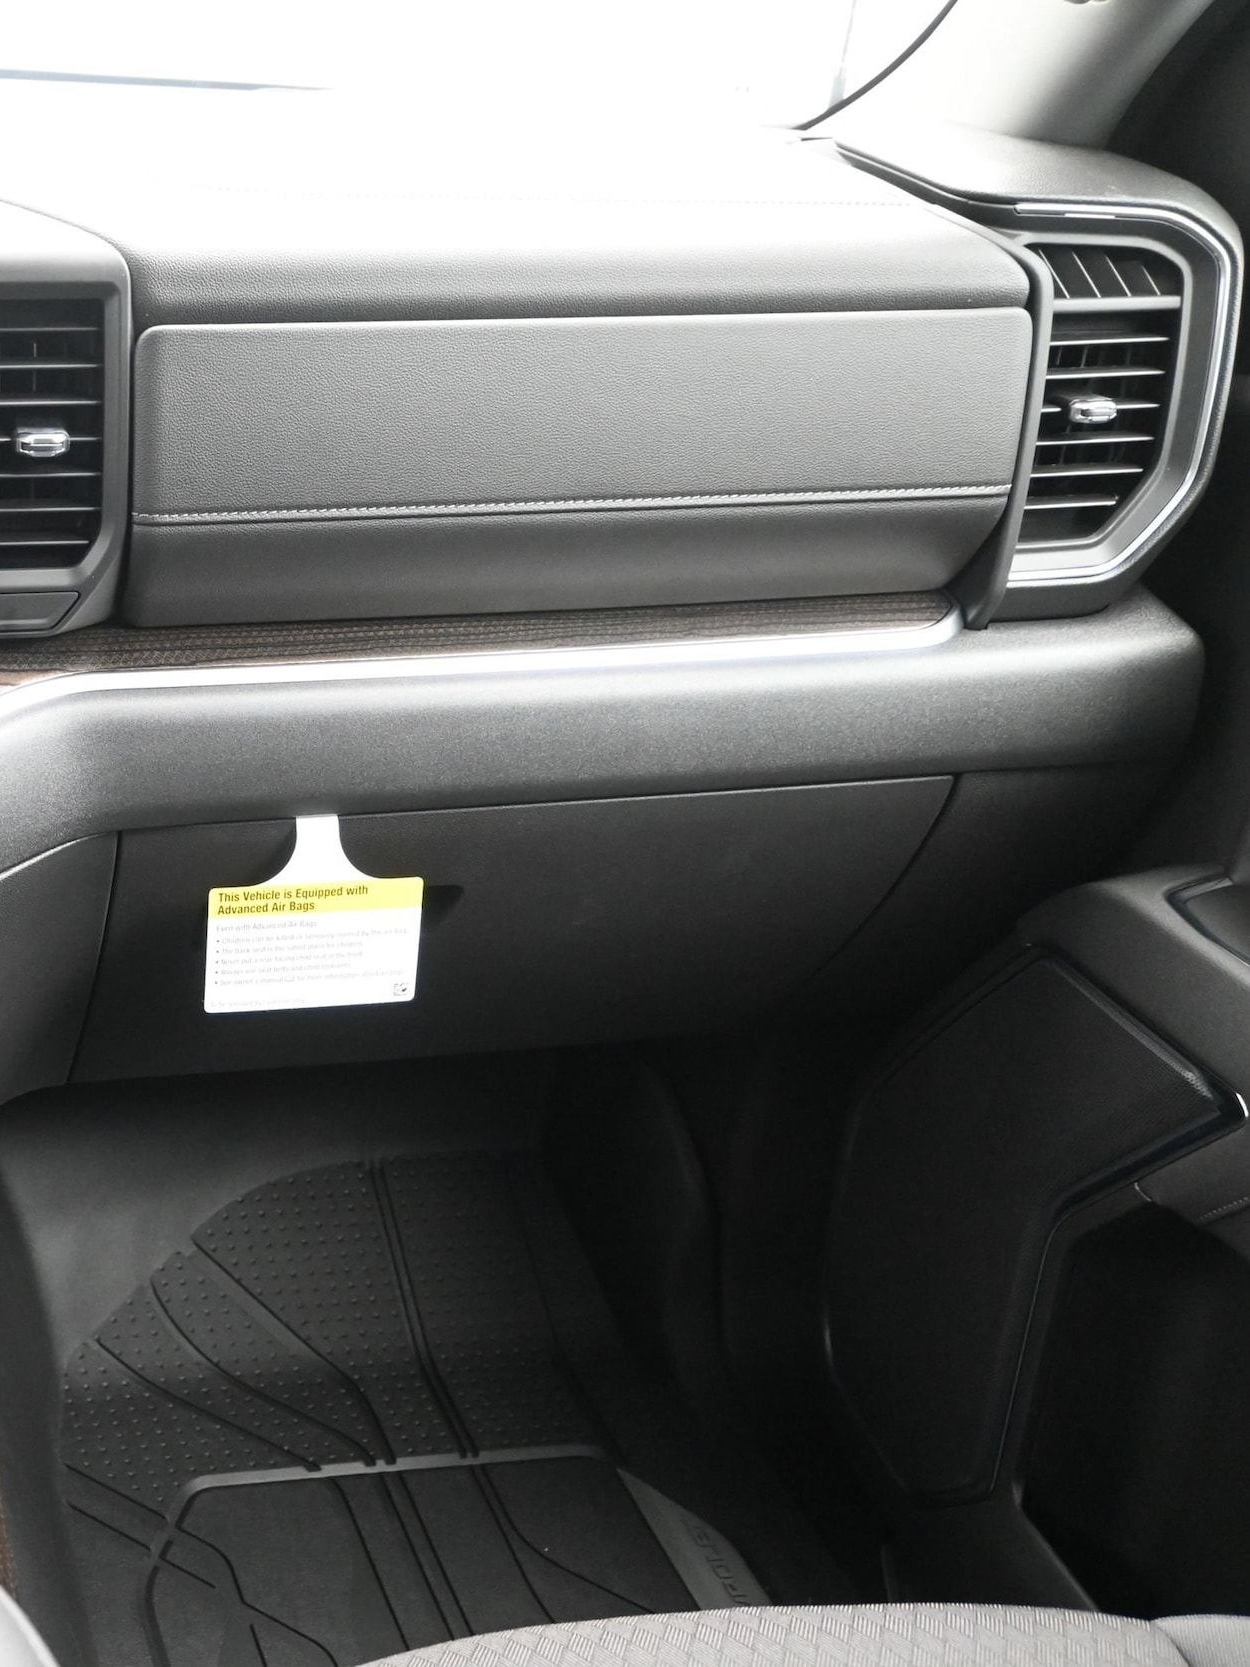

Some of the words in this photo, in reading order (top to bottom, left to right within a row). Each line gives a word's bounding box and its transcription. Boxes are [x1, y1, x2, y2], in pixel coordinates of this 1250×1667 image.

[218, 892, 240, 903] This
[243, 890, 281, 901] Vehicle
[283, 889, 293, 899] is
[295, 886, 343, 901] Equipped
[346, 885, 369, 896] with
[217, 903, 269, 915] Advanced
[271, 902, 287, 912] Air
[289, 901, 316, 913] Bags
[216, 924, 233, 932] Even
[235, 923, 251, 931] with
[252, 921, 286, 931] Advanced
[288, 920, 298, 929] Air
[299, 920, 317, 929] Bags
